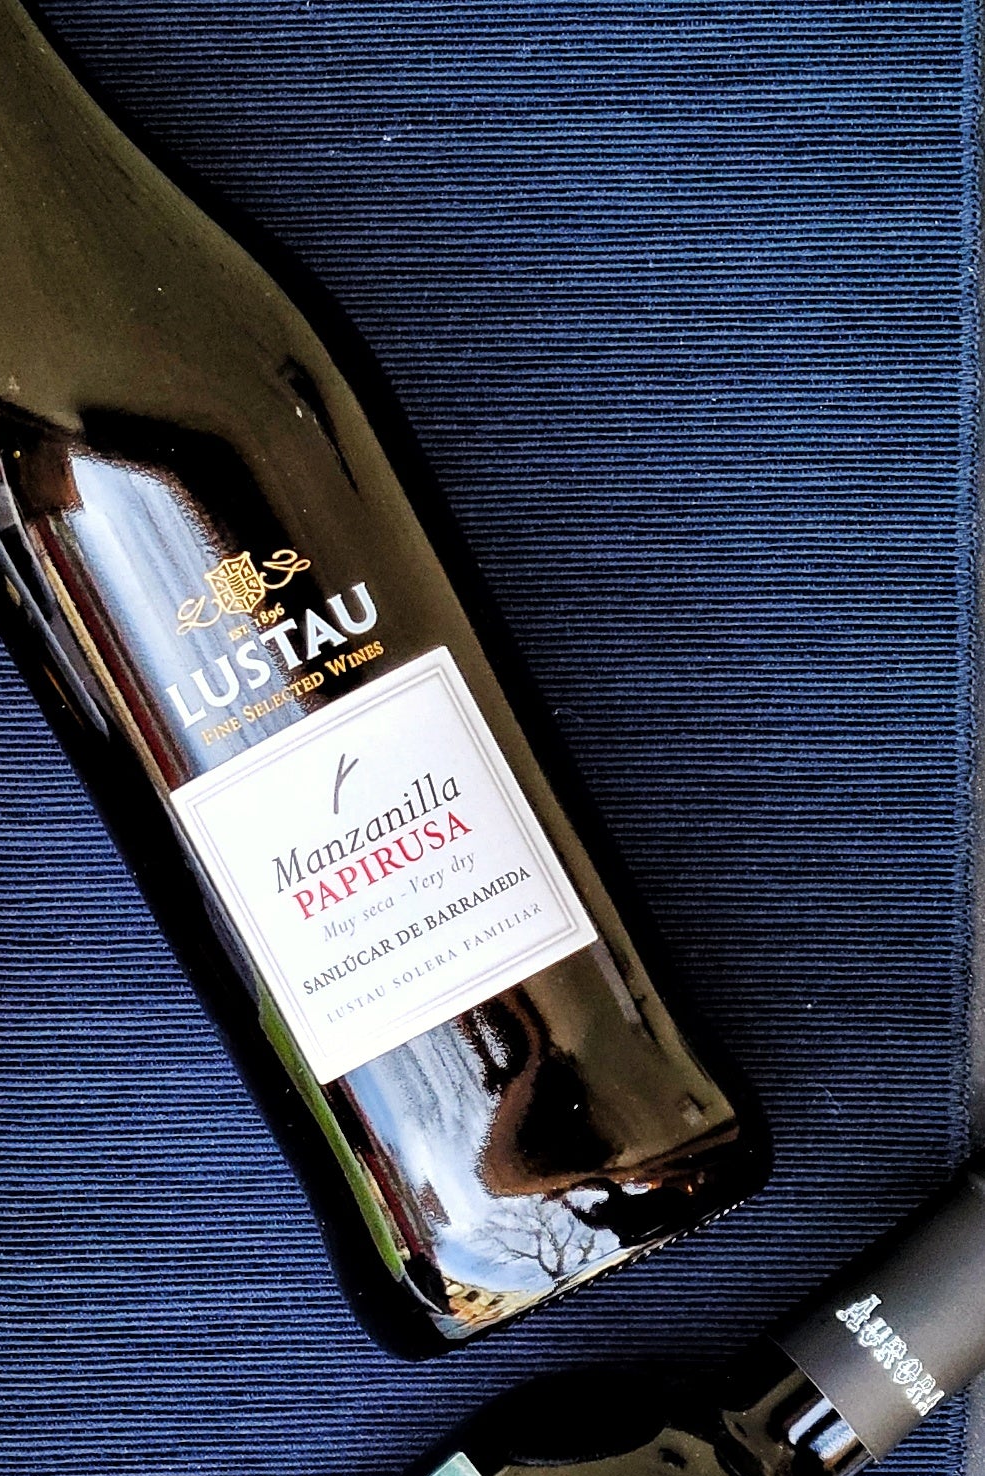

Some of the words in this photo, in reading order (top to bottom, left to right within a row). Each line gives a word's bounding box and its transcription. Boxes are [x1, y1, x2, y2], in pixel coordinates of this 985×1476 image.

[166, 581, 378, 729] LUSTAU
[253, 602, 286, 629] 1896
[200, 716, 243, 746] FINE
[243, 671, 324, 724] SELECTED
[324, 640, 384, 677] WINES
[271, 773, 462, 893] Manzanilla
[292, 811, 473, 920] PAPIRUSA
[303, 936, 395, 996] SANLÚCAR
[395, 923, 424, 947] DE
[423, 865, 532, 931] BARRAMEDA
[322, 915, 358, 942] Muy
[362, 896, 396, 922] seca
[407, 870, 446, 898] Very
[450, 852, 476, 876] dry
[327, 984, 387, 1024] LUSTAU
[392, 948, 458, 990] SOLERA
[462, 902, 543, 952] FAMILIAR
[836, 1294, 945, 1417] AURORA
